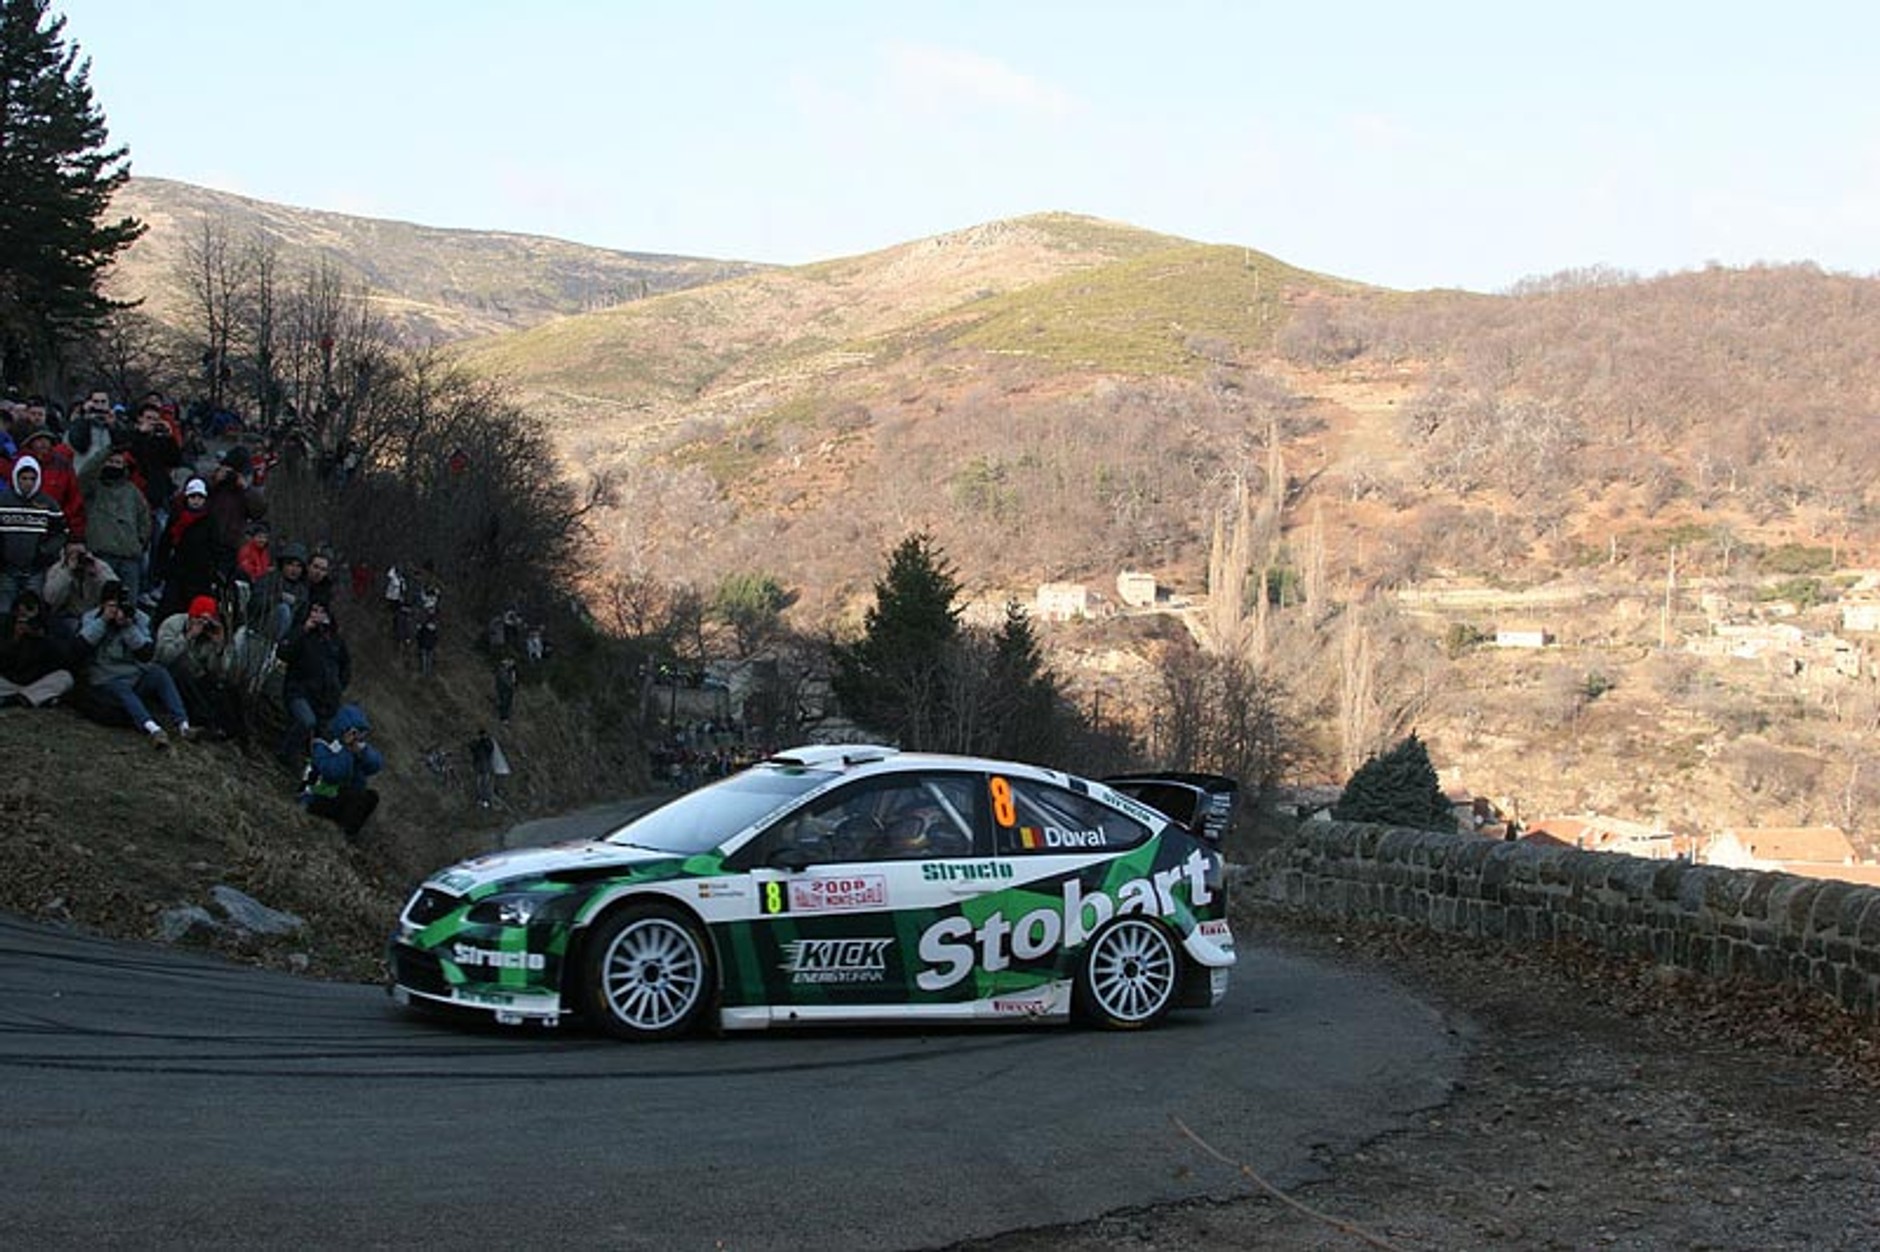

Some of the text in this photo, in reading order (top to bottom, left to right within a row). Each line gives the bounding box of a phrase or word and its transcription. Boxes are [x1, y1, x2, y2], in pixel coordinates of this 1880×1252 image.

[989, 776, 1016, 828] 8
[1045, 826, 1106, 847] Duval
[922, 860, 1013, 881] Structo
[766, 881, 781, 914] 8
[916, 848, 1212, 991] Stobart
[790, 938, 893, 971] KICK
